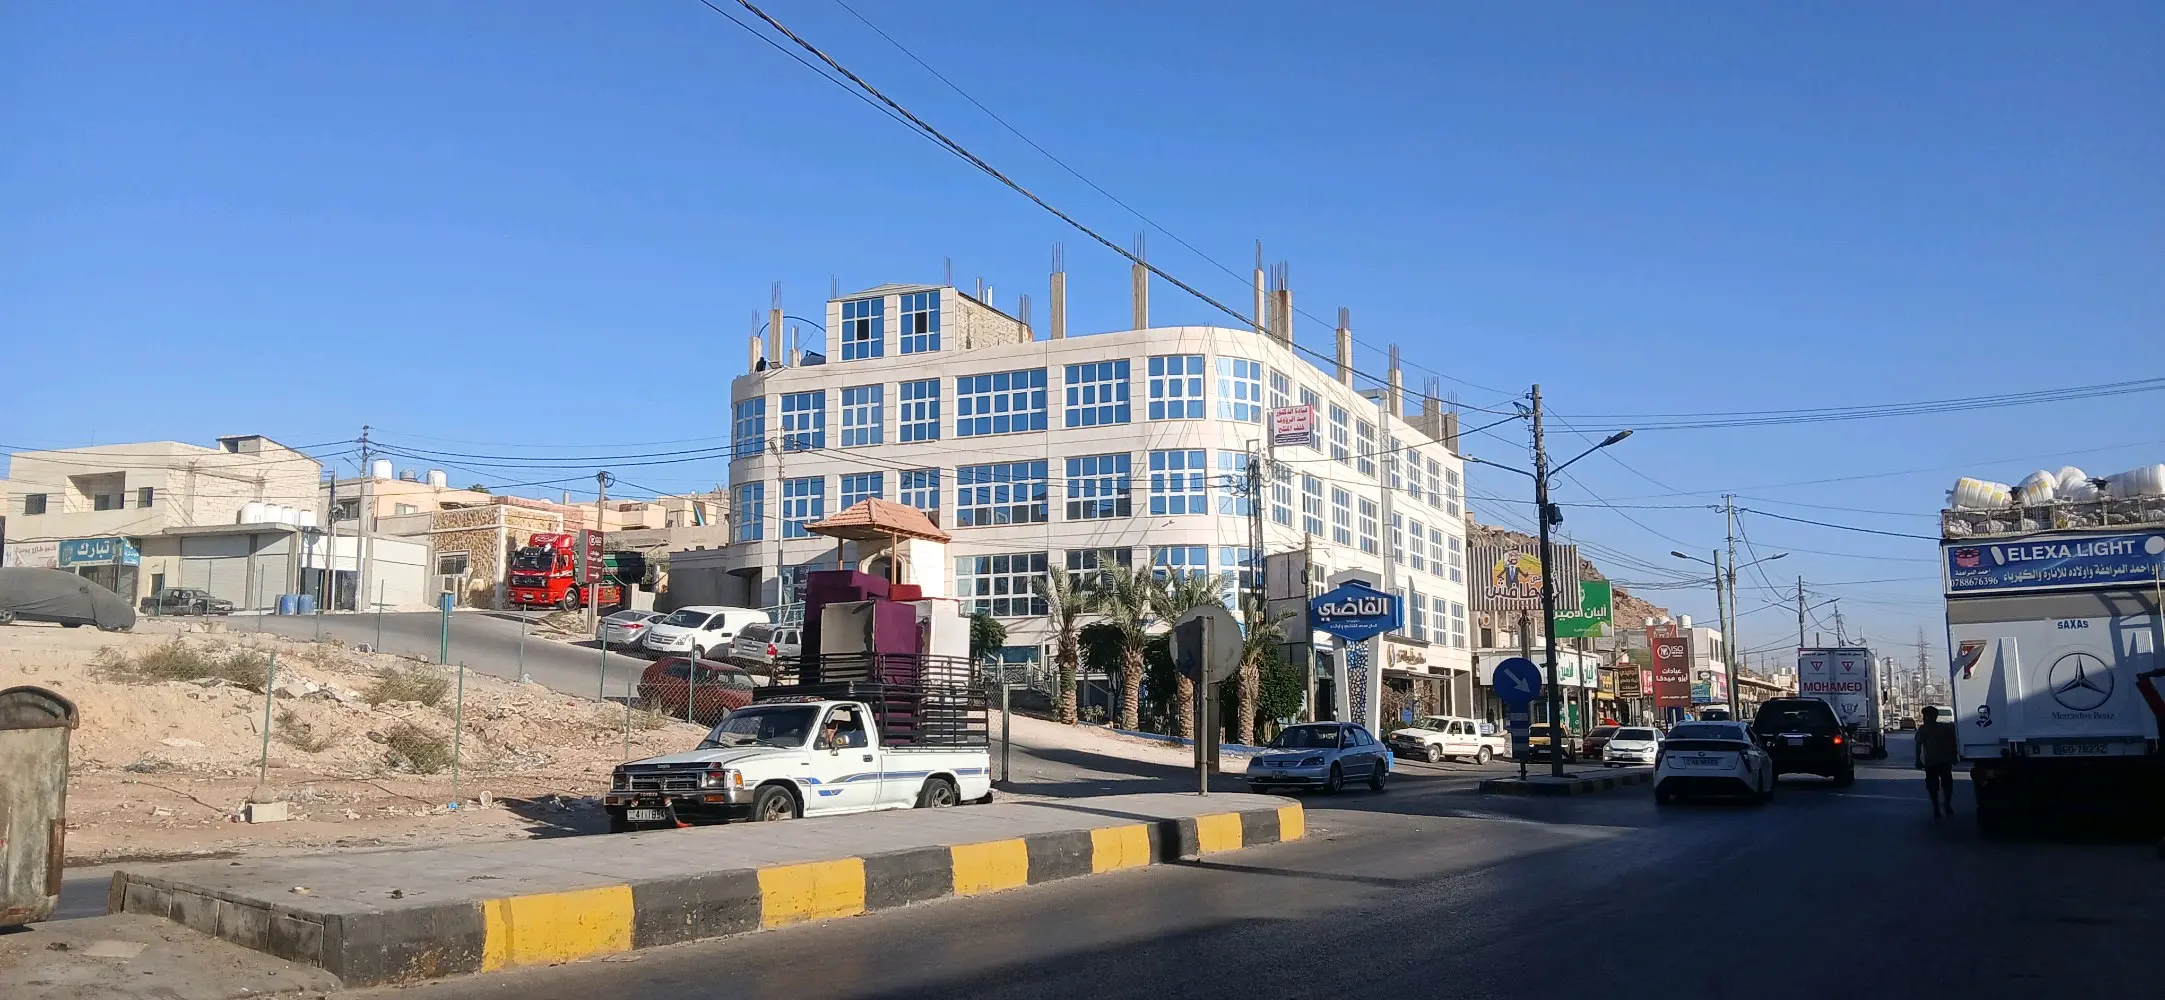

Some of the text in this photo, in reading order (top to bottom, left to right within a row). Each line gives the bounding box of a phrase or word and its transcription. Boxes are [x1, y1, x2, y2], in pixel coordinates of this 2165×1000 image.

[77, 540, 110, 558] تبارك
[2008, 540, 2136, 562] ELEXA LIGHT
[1318, 597, 1388, 622] القاضي
[2057, 619, 2089, 630] SAXAS
[1803, 681, 1862, 692] MOHAMED
